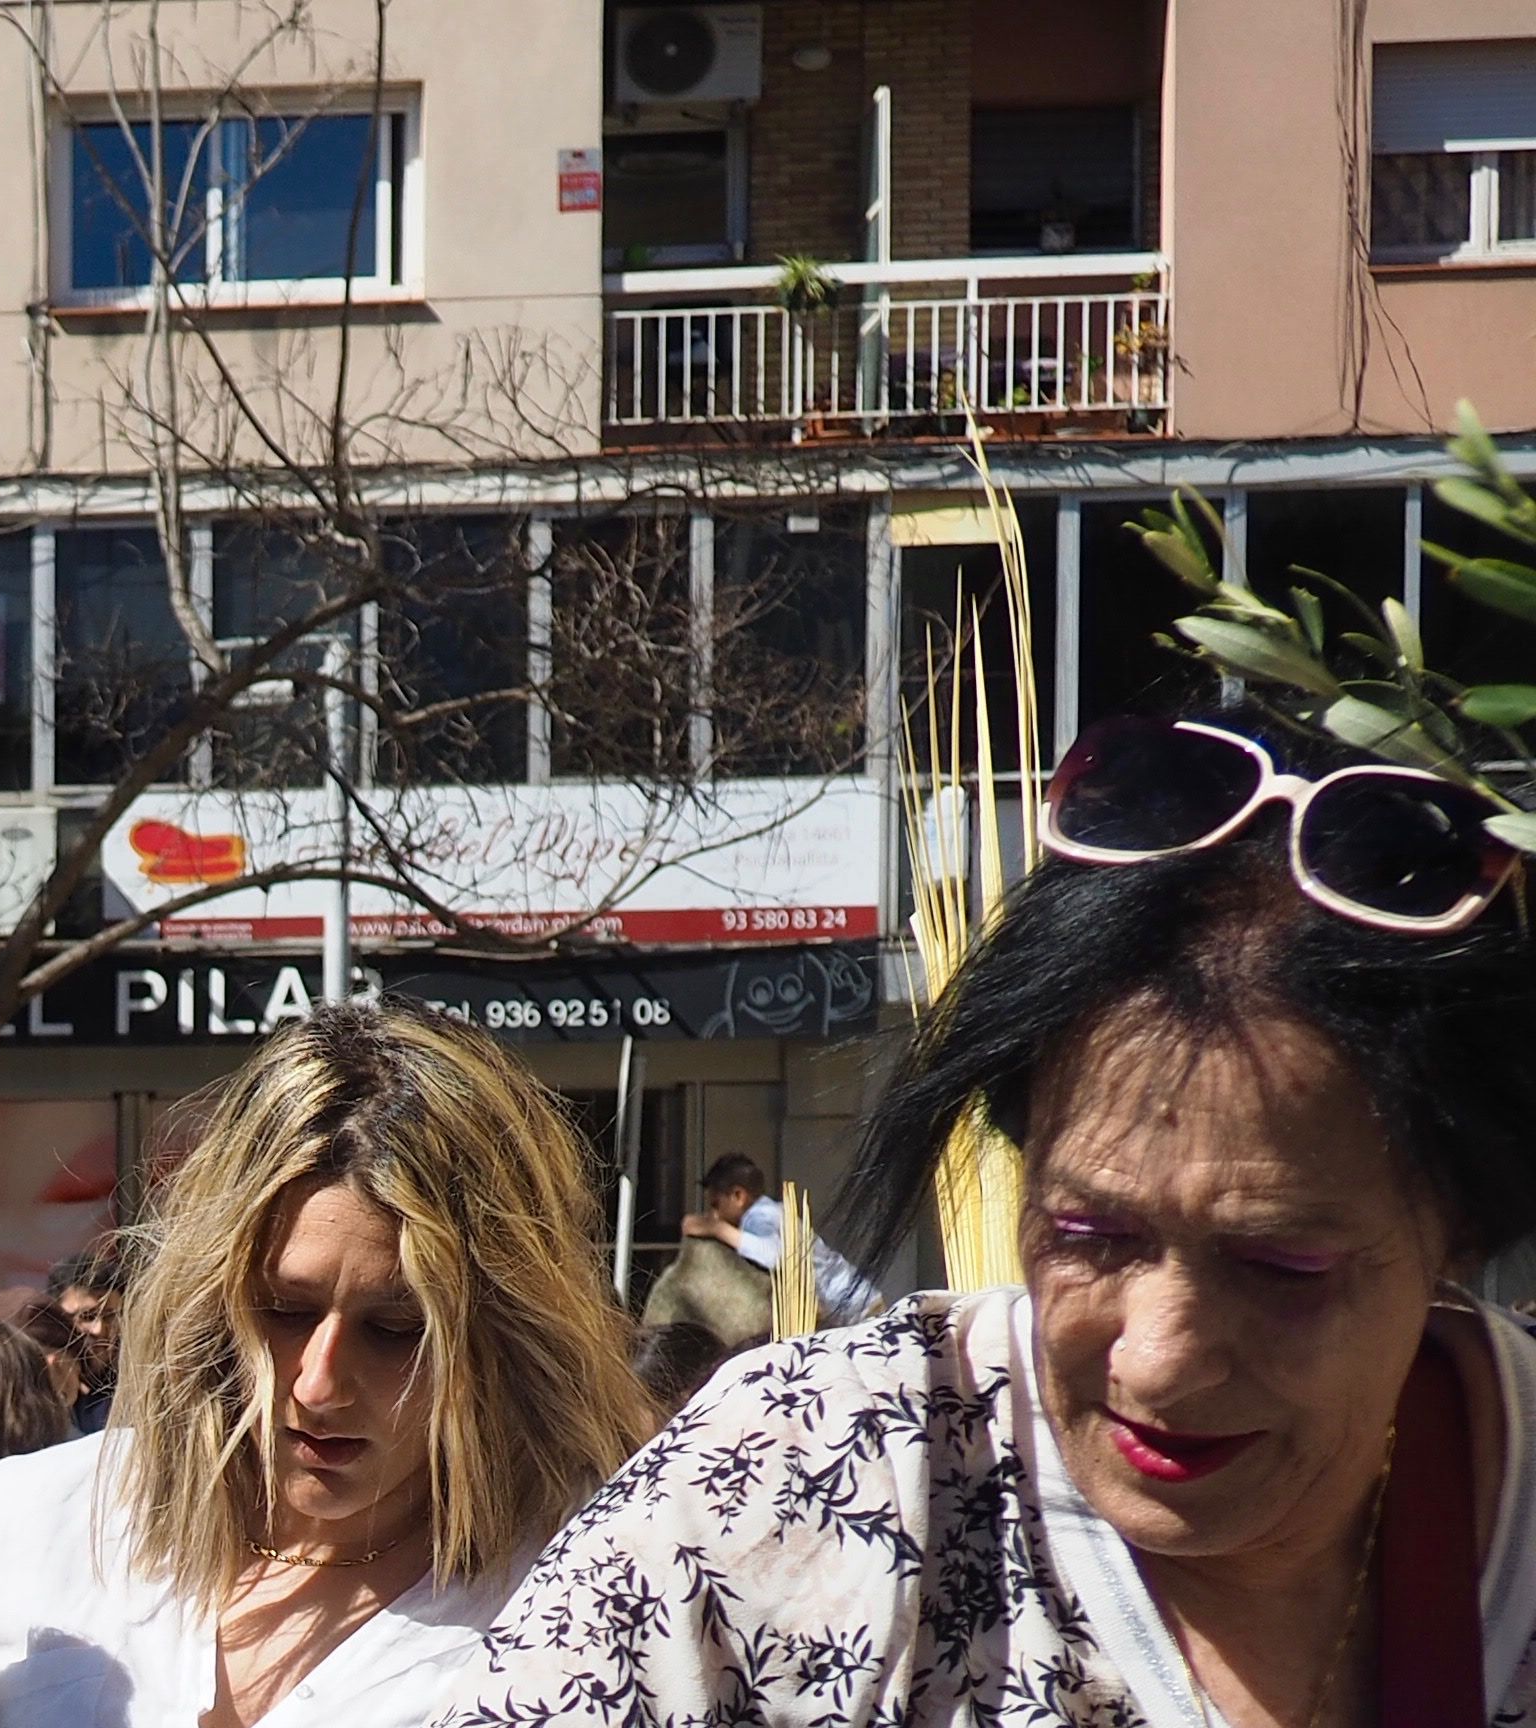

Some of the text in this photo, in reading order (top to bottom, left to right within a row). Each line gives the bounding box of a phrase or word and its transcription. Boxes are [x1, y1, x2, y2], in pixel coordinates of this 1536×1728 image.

[722, 908, 748, 931] 93
[751, 908, 790, 931] 580
[821, 907, 848, 929] 24
[485, 999, 542, 1029] 936
